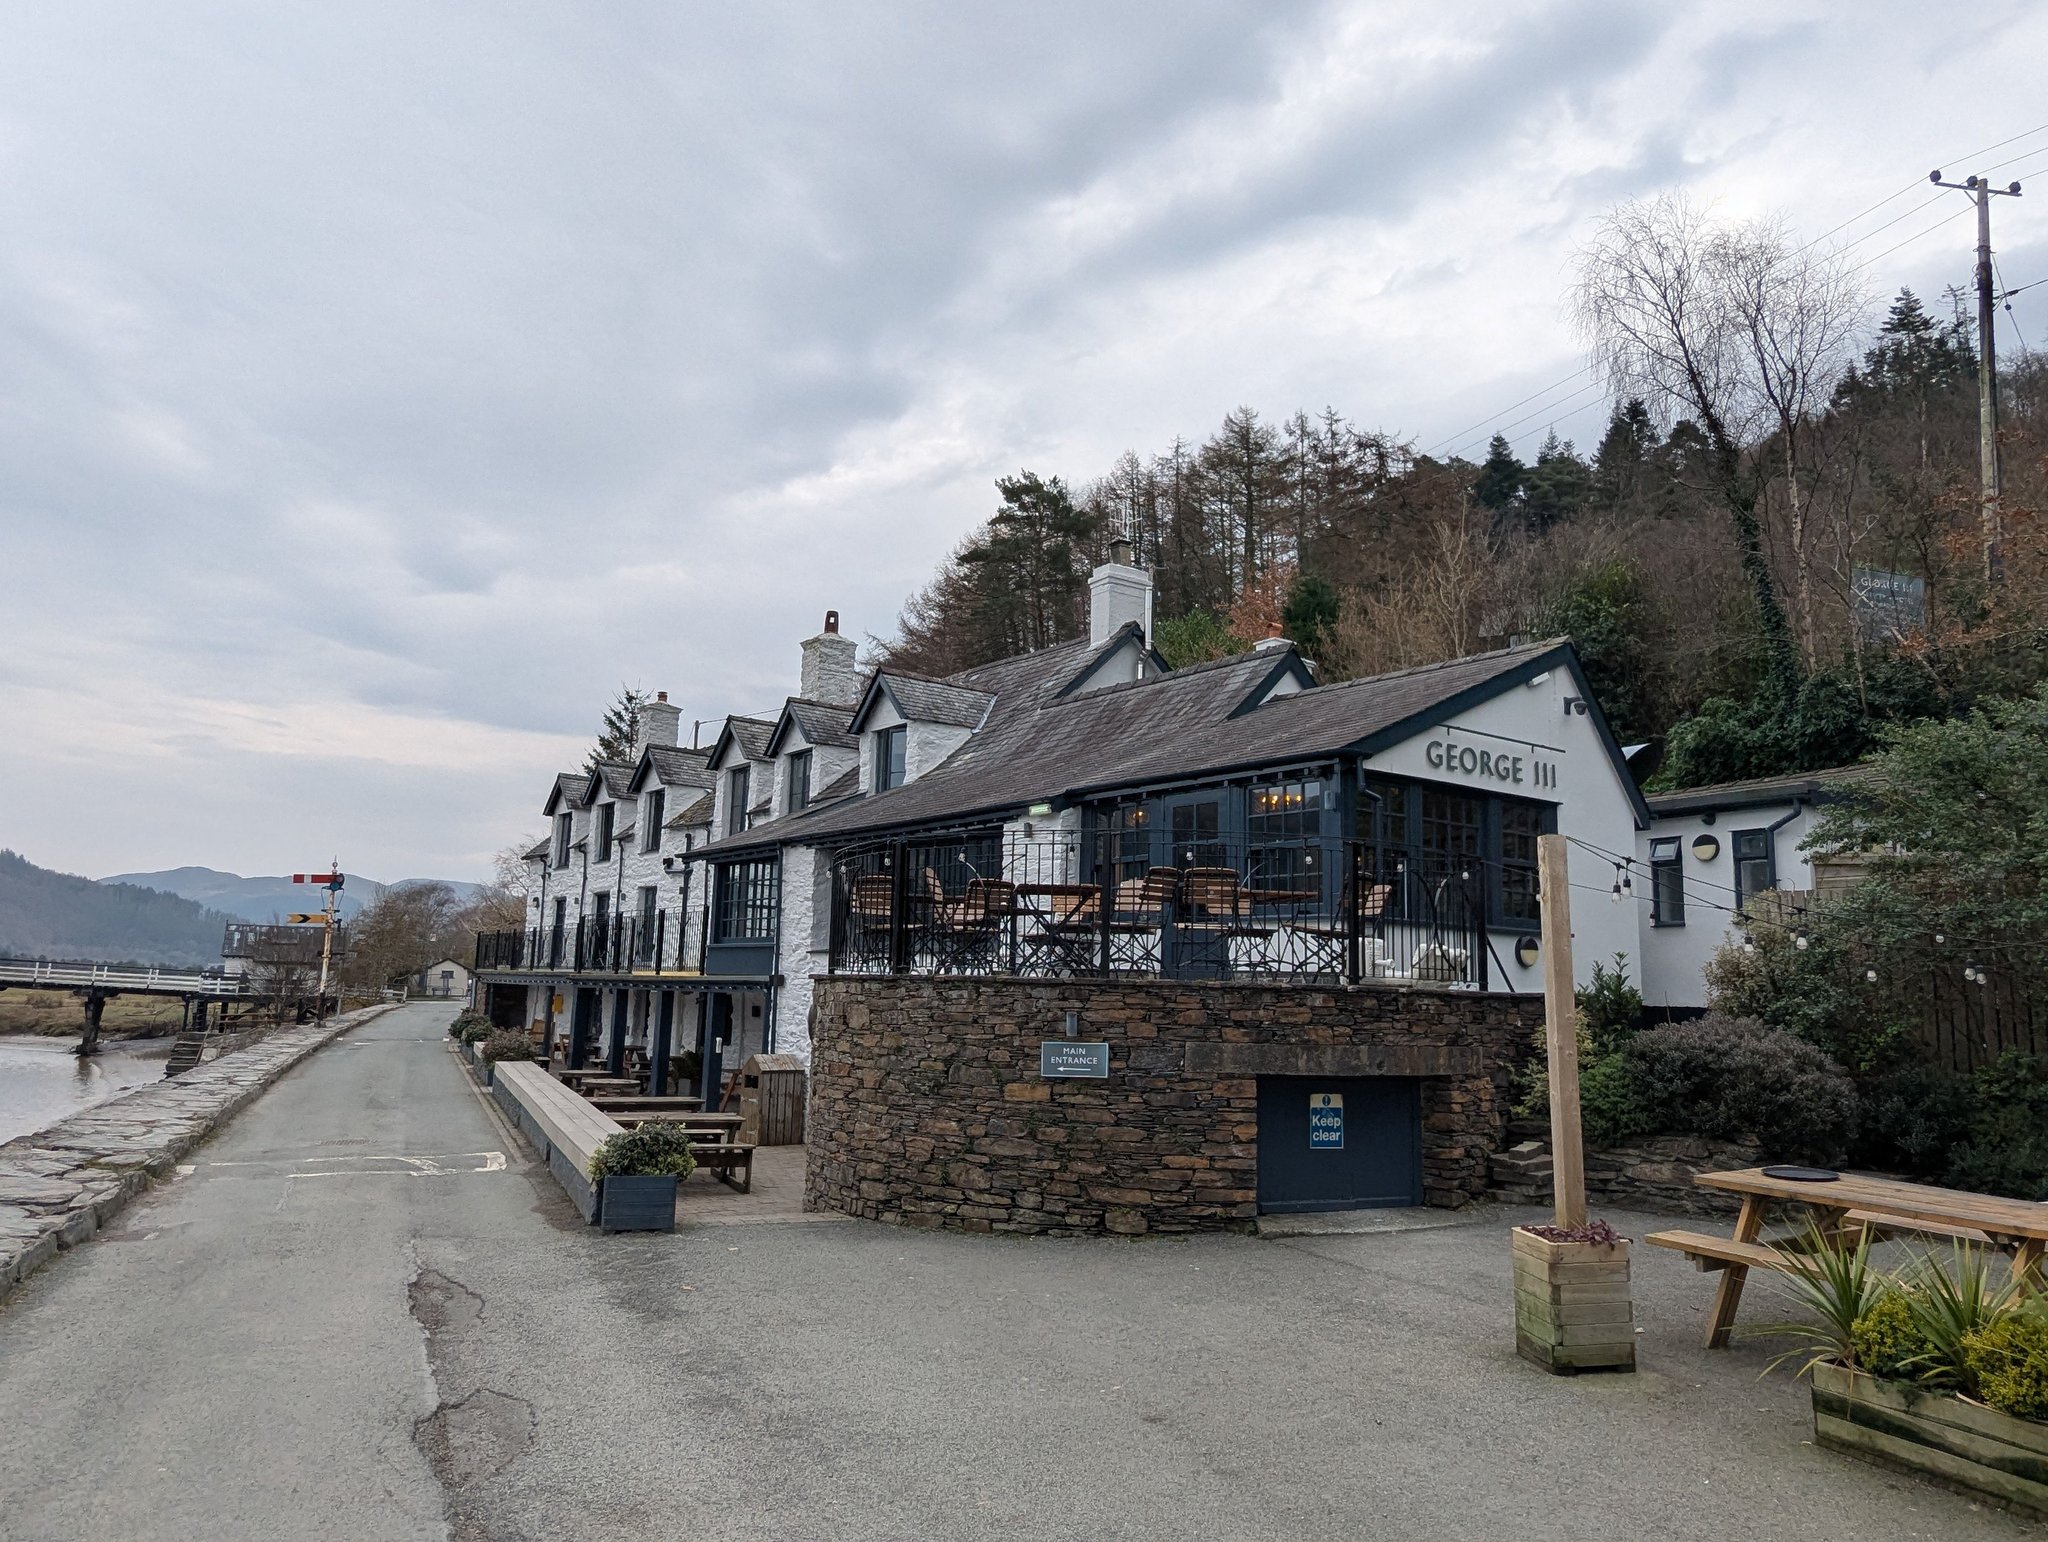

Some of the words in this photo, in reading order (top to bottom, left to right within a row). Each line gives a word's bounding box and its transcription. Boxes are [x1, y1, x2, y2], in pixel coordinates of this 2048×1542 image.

[1426, 740, 1524, 784] GEORGE
[1533, 760, 1557, 789] III
[1062, 1047, 1086, 1055] MAIN
[1050, 1056, 1098, 1065] ENTRANCE
[1312, 1114, 1341, 1129] Keep
[1312, 1129, 1341, 1141] clear
